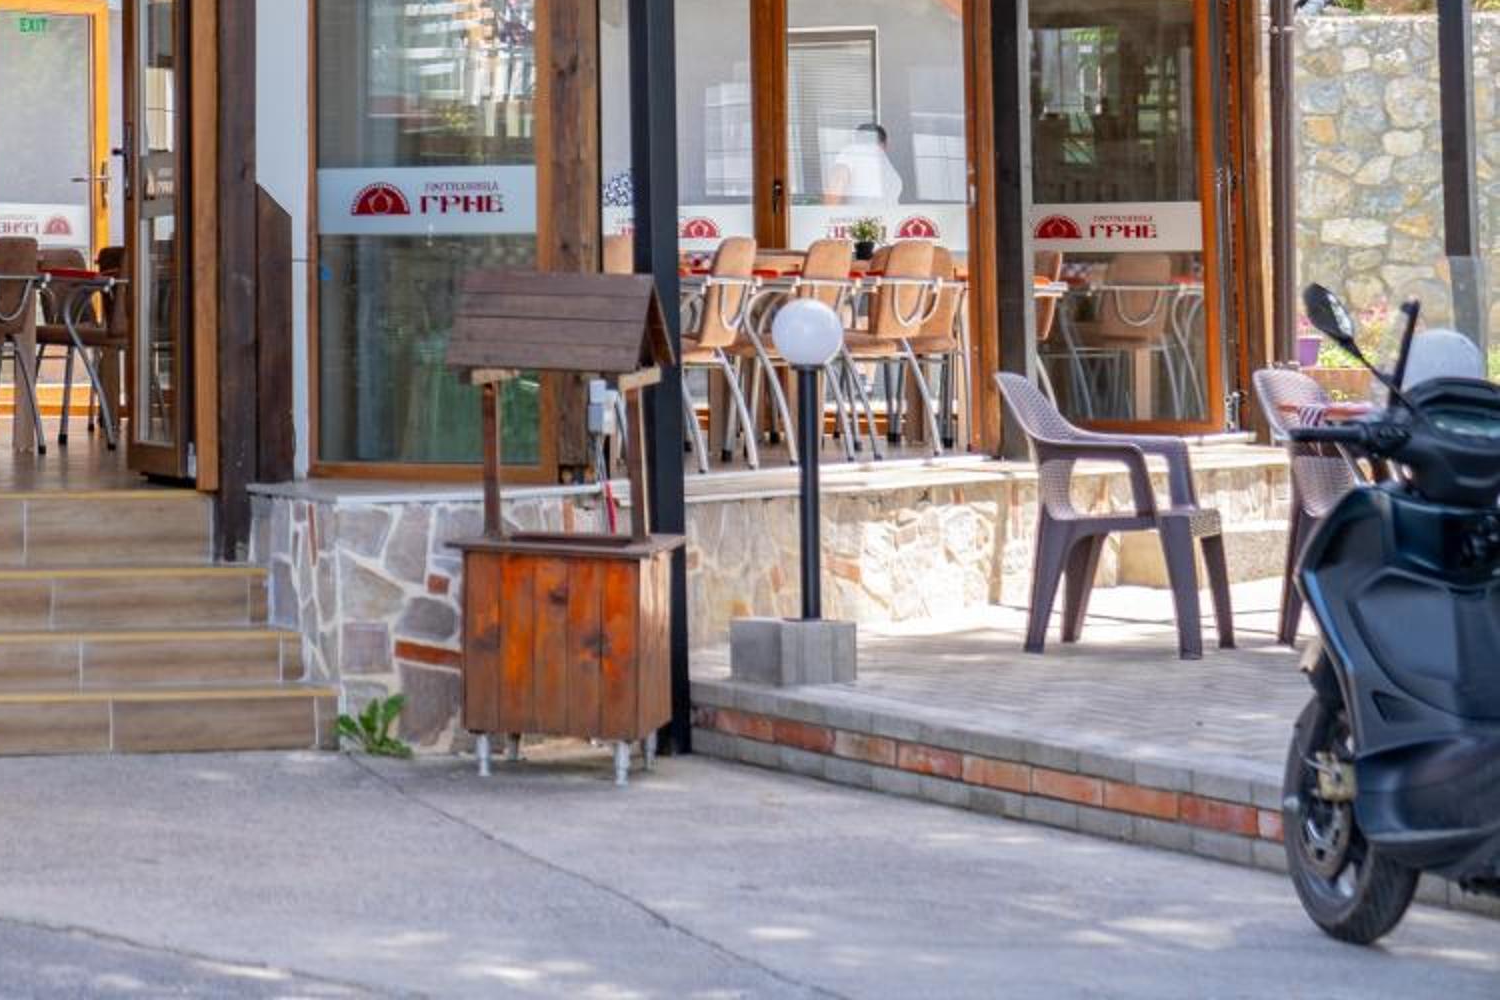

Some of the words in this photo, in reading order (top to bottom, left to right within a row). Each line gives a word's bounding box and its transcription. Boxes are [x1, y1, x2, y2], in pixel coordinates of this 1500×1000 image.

[19, 16, 48, 34] EXIT
[419, 194, 505, 213] ГРНЕ
[1090, 223, 1157, 239] ГРНЕ
